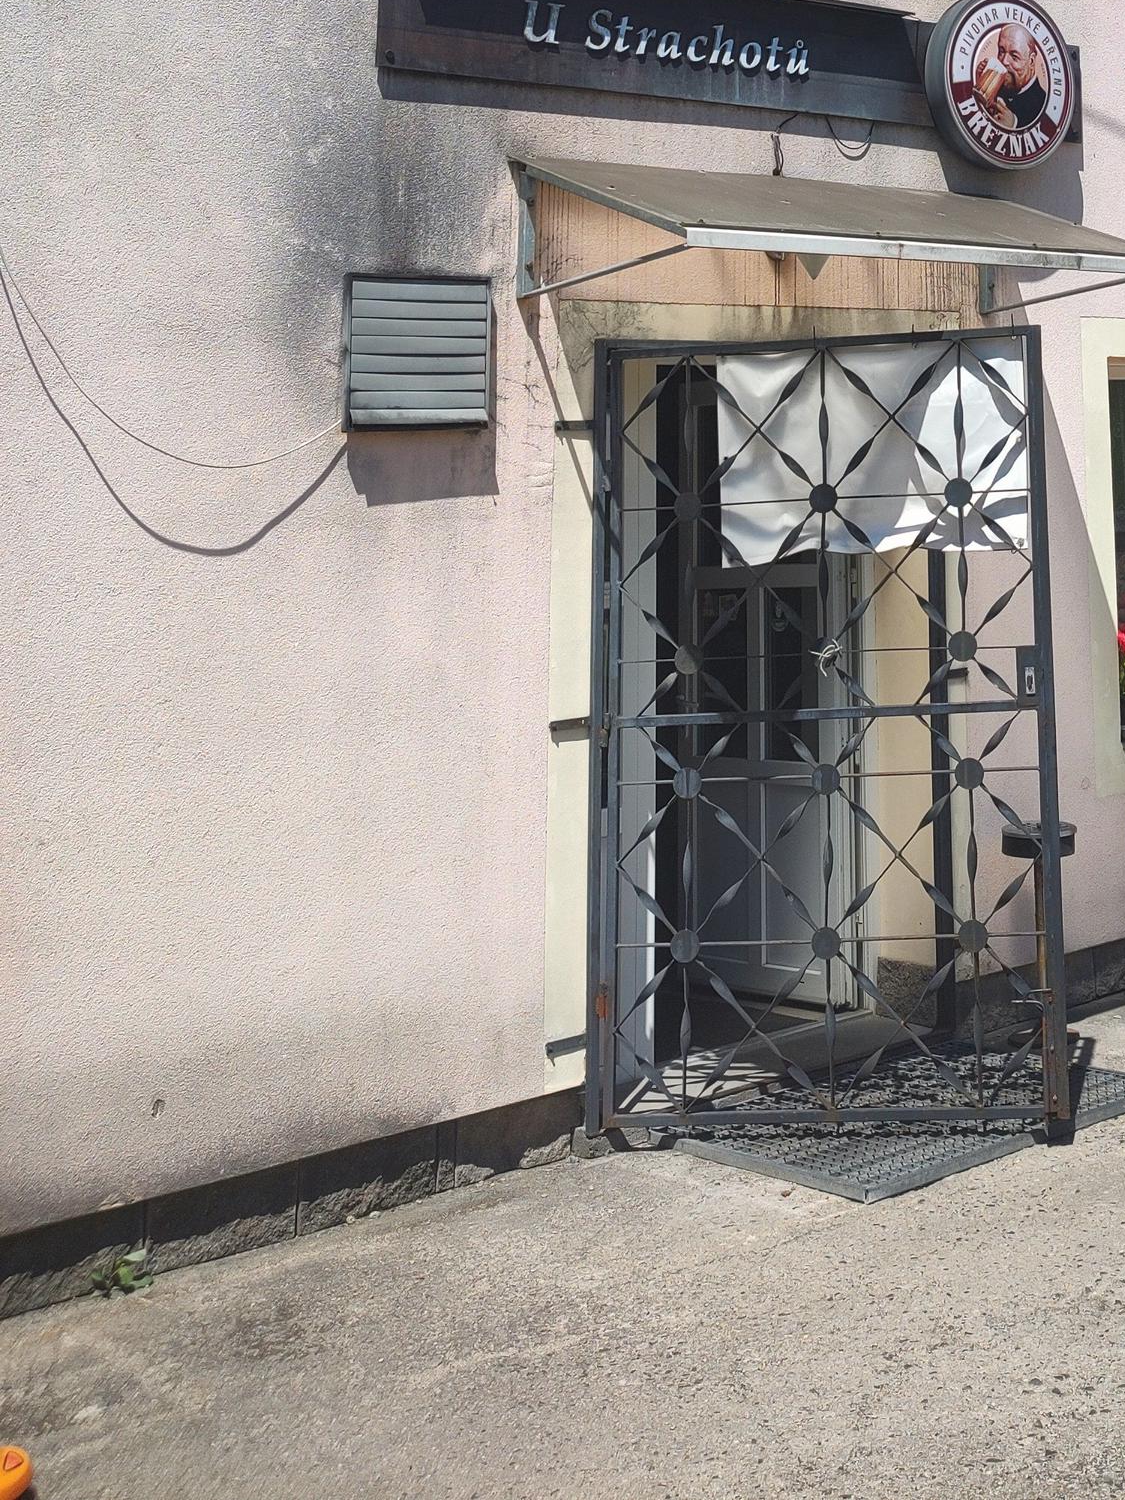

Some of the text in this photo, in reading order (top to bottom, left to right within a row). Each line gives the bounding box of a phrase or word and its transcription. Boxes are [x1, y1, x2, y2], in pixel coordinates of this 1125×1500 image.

[523, 0, 810, 76] U Strachotů
[959, 6, 1062, 97] PIVOVAR VELKÉ BŘEZNO
[957, 95, 1050, 157] BŘEZŇÁK
